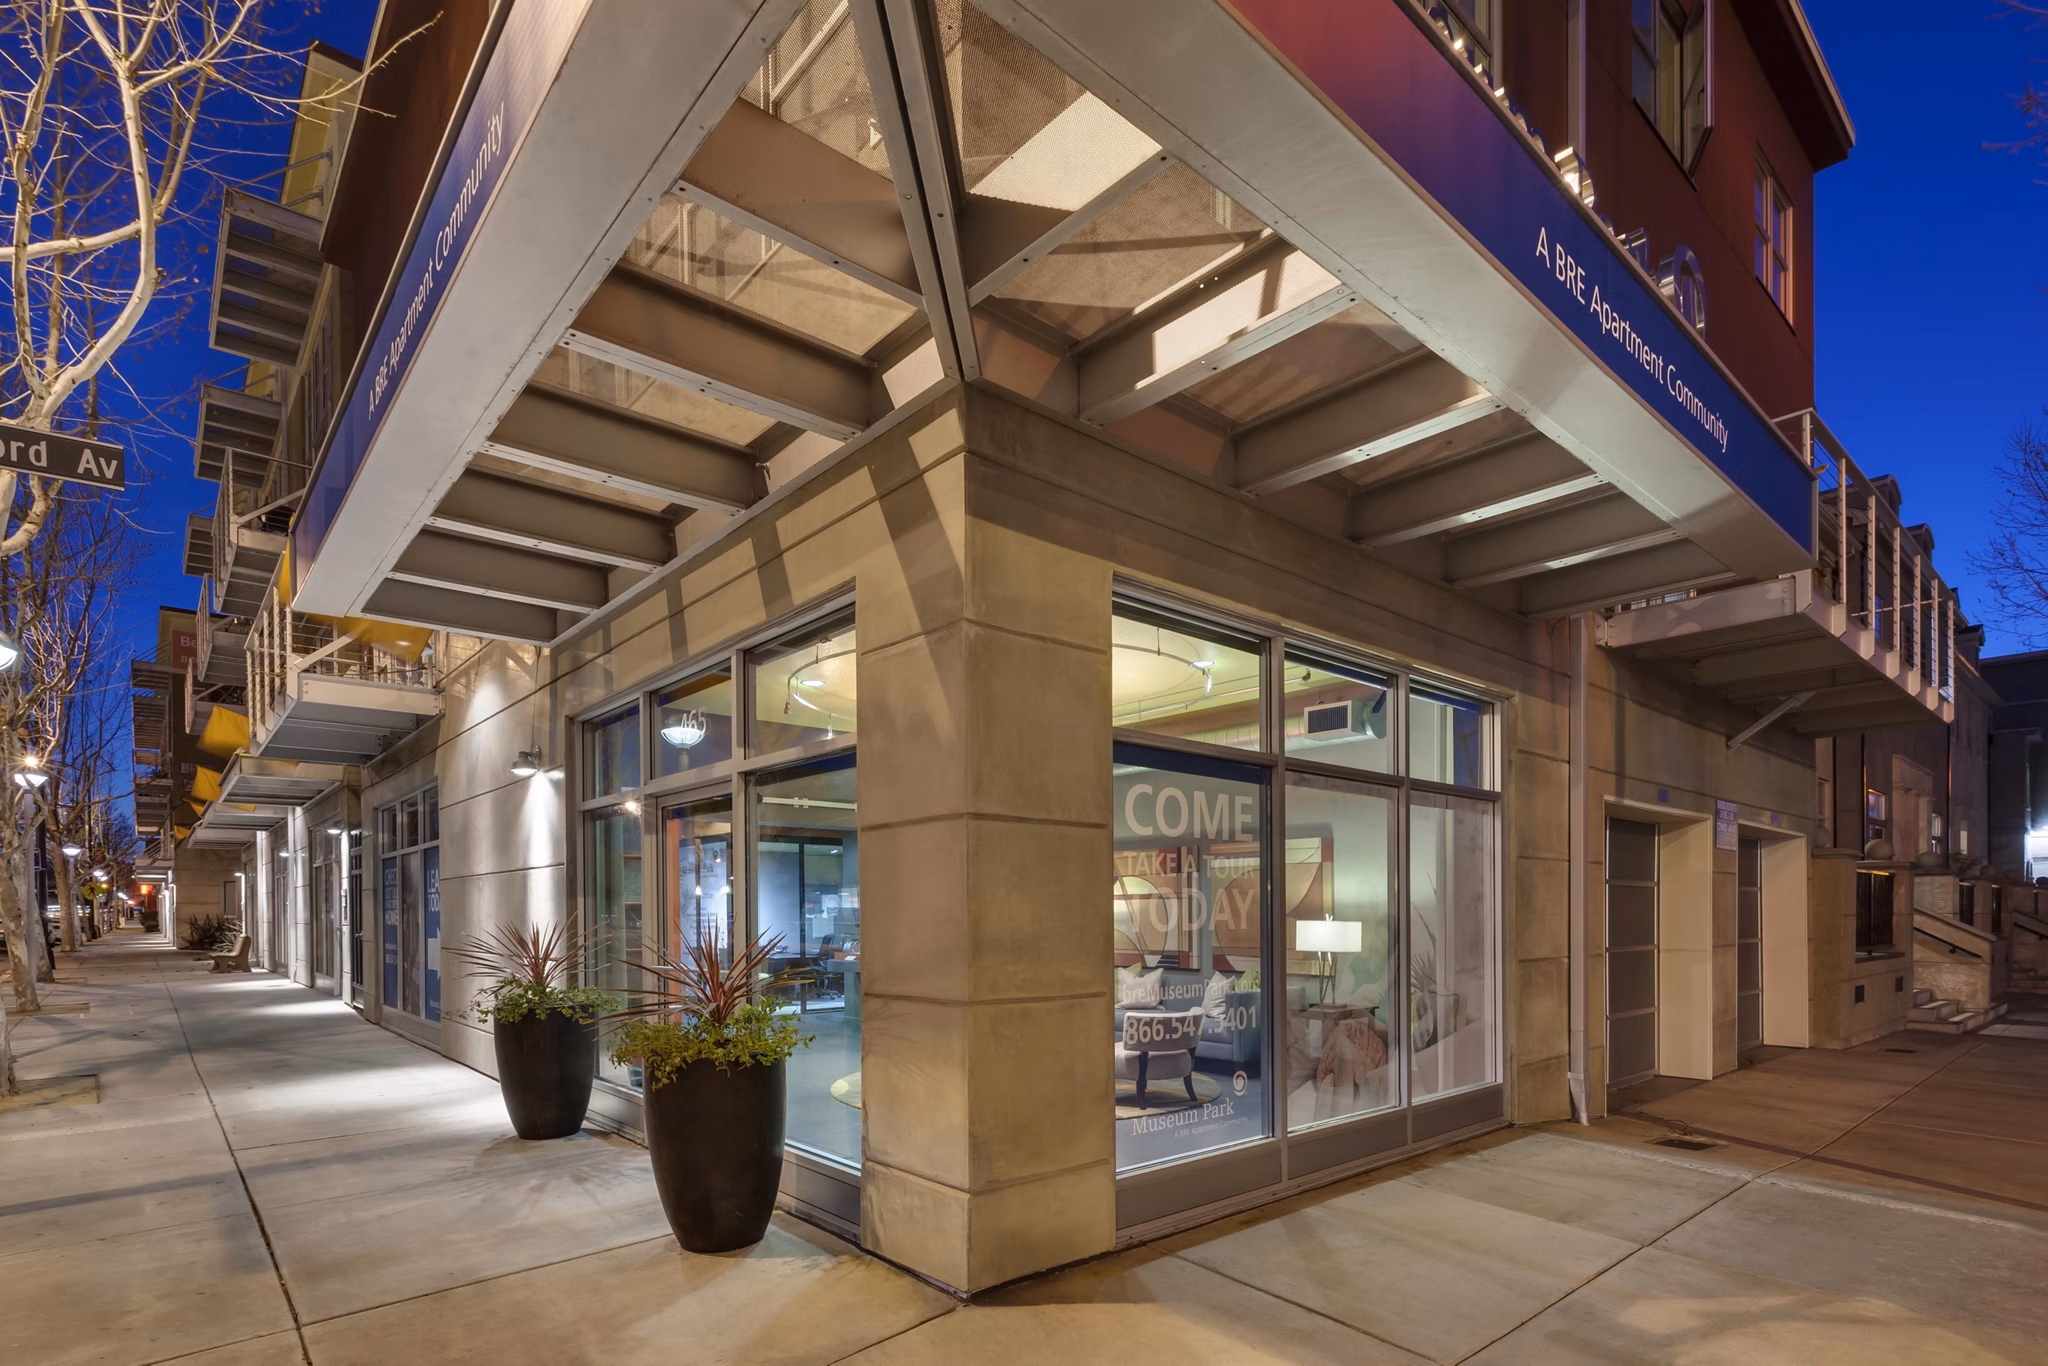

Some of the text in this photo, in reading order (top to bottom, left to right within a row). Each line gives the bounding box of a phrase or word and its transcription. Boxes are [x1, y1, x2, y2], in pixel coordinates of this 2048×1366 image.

[368, 101, 504, 421] A BRE Apartment Community
[1535, 226, 1728, 453] A BRE Apartment Community
[77, 448, 118, 479] Av
[1124, 783, 1253, 842] COME
[1122, 850, 1256, 880] TAKE A TOUR
[1127, 886, 1256, 933] TODAY
[1126, 1005, 1257, 1045] 866.547.5401
[1131, 1097, 1235, 1137] Museum Park
